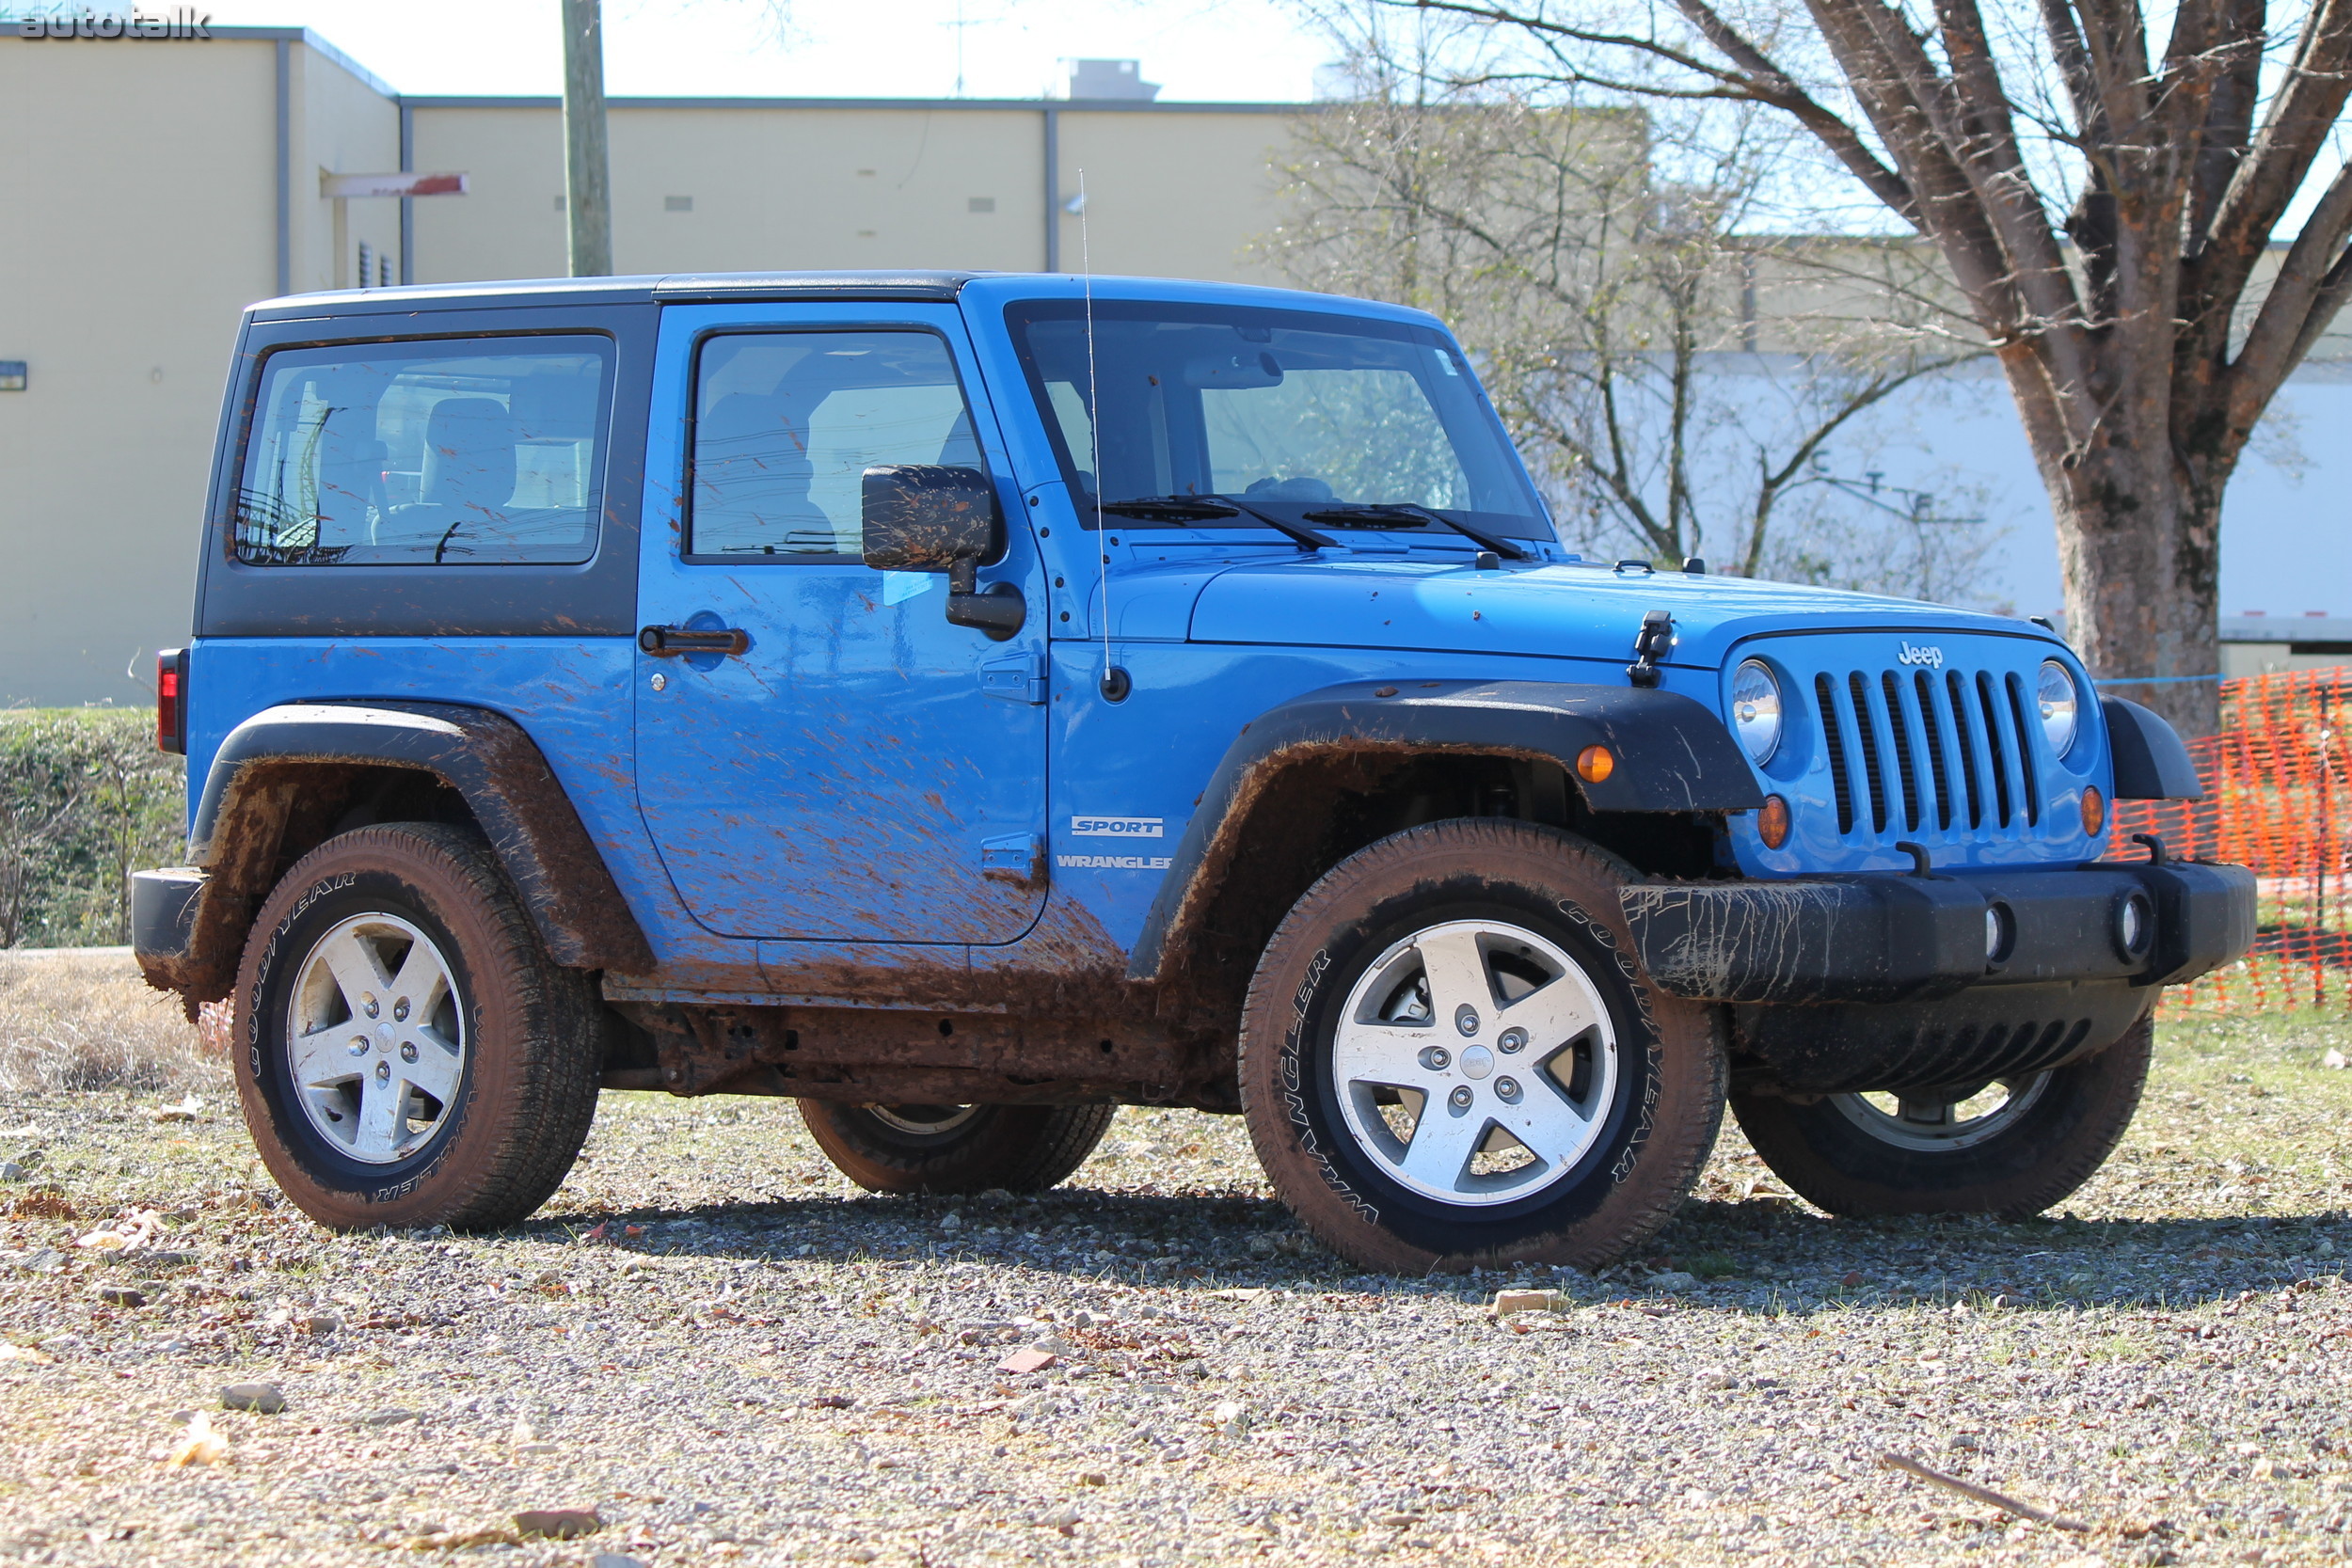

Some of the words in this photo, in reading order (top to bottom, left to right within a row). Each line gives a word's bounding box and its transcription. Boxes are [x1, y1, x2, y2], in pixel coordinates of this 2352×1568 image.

[1898, 641, 1944, 670] Jeep
[1076, 820, 1159, 833] SPORT
[247, 871, 357, 1078] GOODYEAR
[1557, 898, 1665, 1183] GOODYEAR
[1280, 948, 1379, 1227] WRANGLER
